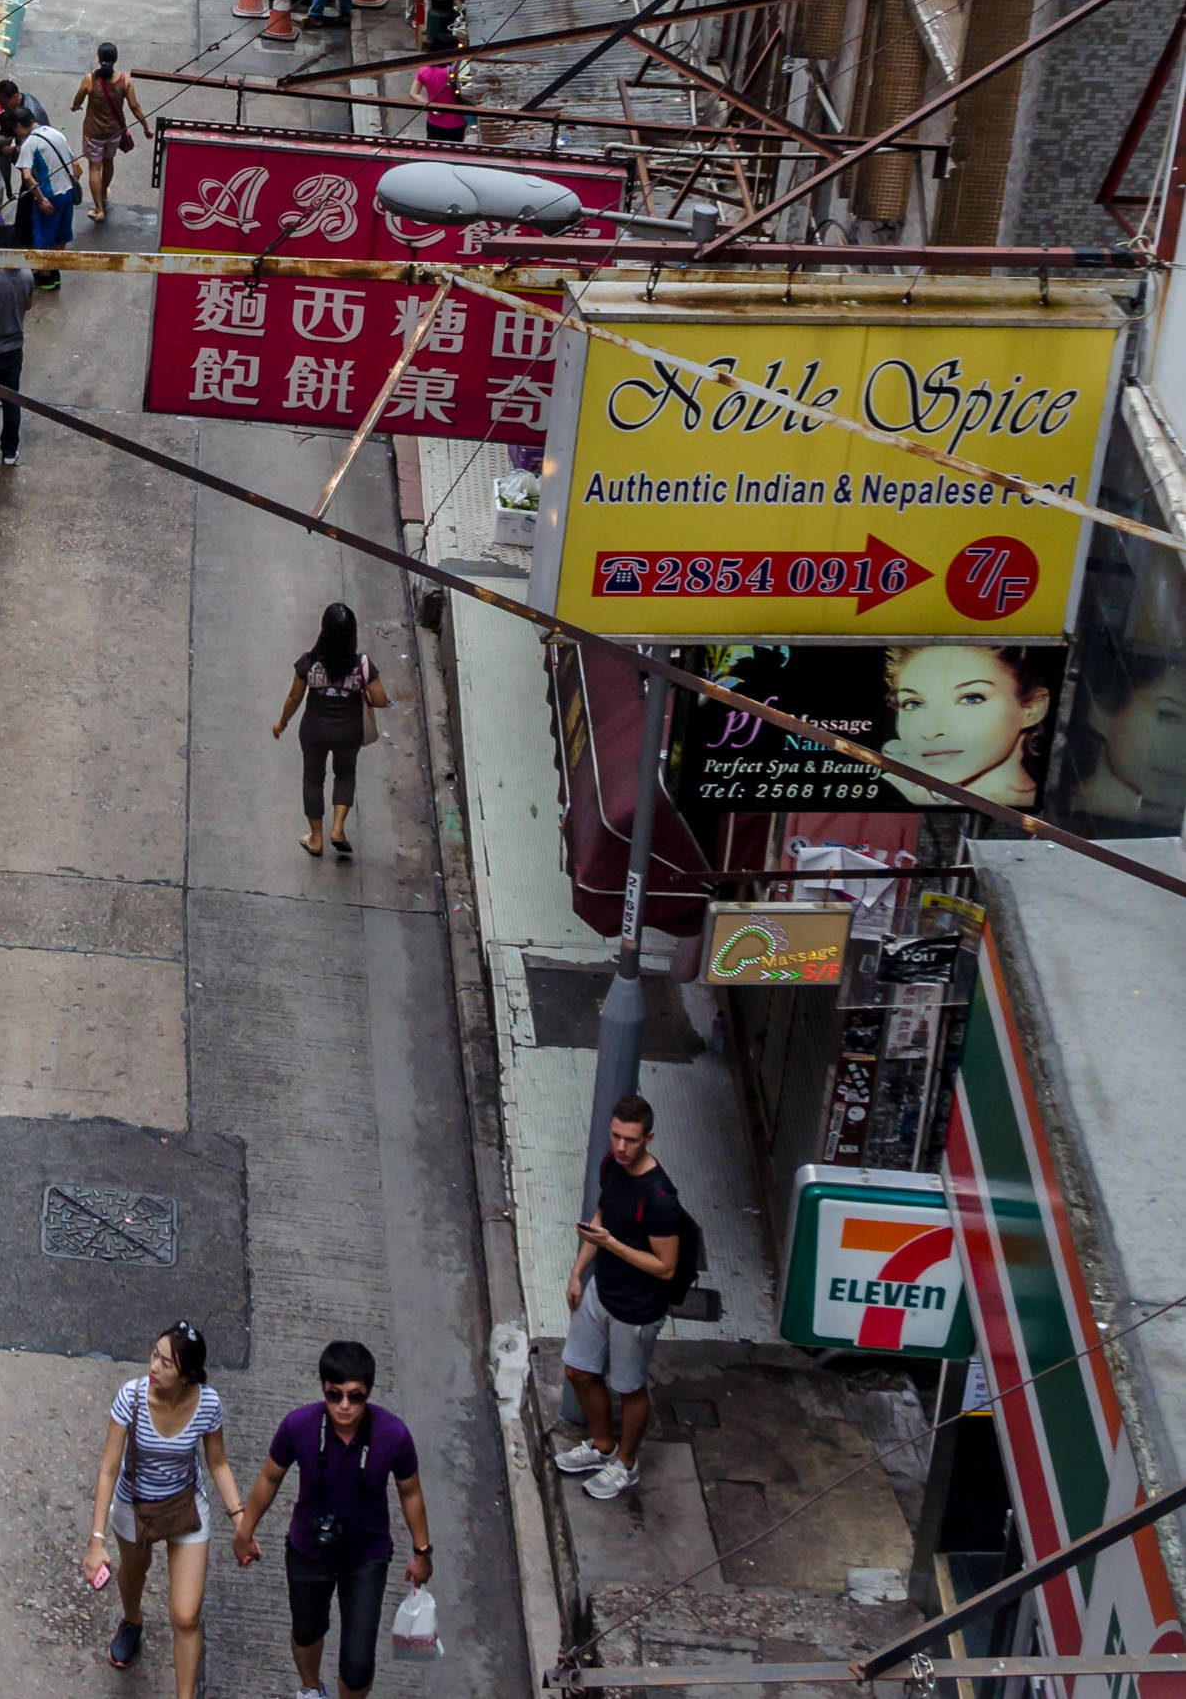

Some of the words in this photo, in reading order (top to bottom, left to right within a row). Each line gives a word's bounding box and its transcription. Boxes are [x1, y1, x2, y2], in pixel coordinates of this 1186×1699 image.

[607, 348, 840, 434] Noble
[864, 357, 1080, 456] Spice
[583, 471, 729, 505] Authentic
[735, 473, 826, 506] Indian
[832, 474, 854, 506] &
[861, 474, 995, 513] Nepalese
[652, 557, 775, 593] 2854
[788, 557, 909, 595] 0916
[965, 547, 1031, 615] 7/F
[704, 757, 763, 779] Perfect
[767, 759, 800, 780] Spa
[803, 760, 816, 774] &
[820, 759, 883, 781] Beauty
[699, 782, 746, 799] Tel:
[755, 783, 815, 799] 2568
[822, 783, 880, 800] 1899
[761, 945, 840, 969] Massage
